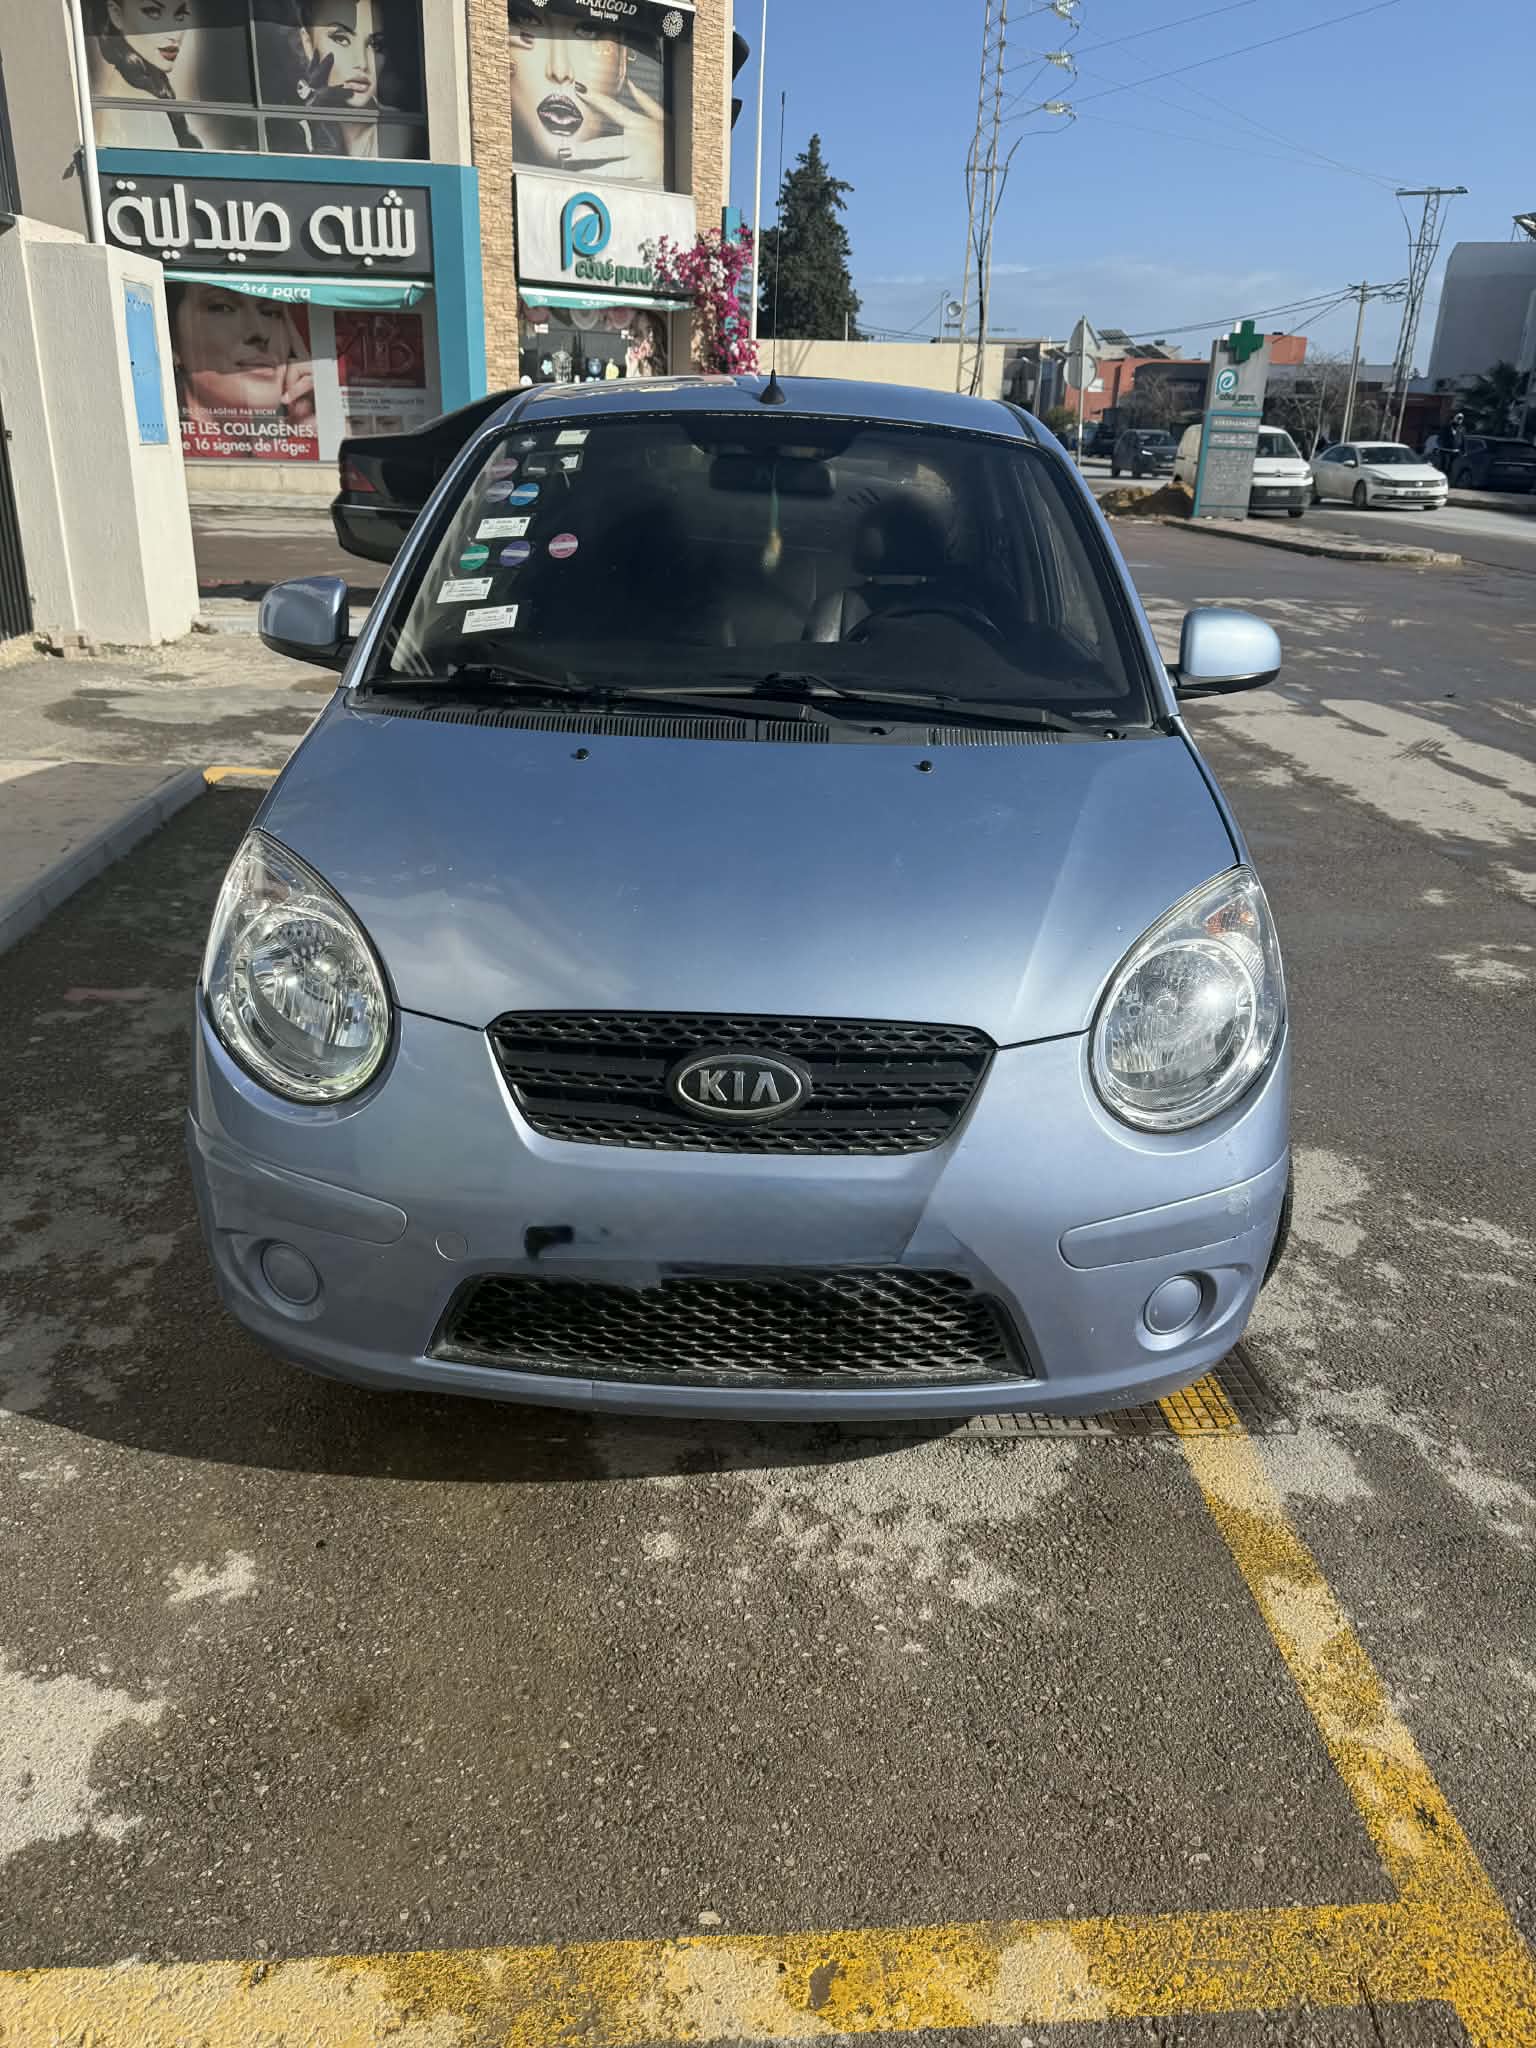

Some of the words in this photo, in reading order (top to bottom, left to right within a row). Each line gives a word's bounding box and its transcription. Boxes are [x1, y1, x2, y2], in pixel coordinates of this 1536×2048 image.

[106, 179, 291, 262] صيدلية
[308, 189, 416, 266] شبه
[193, 437, 211, 451] 16
[212, 438, 252, 455] signes
[253, 439, 272, 453] de
[199, 422, 221, 436] LES
[698, 1069, 781, 1103] KIA
